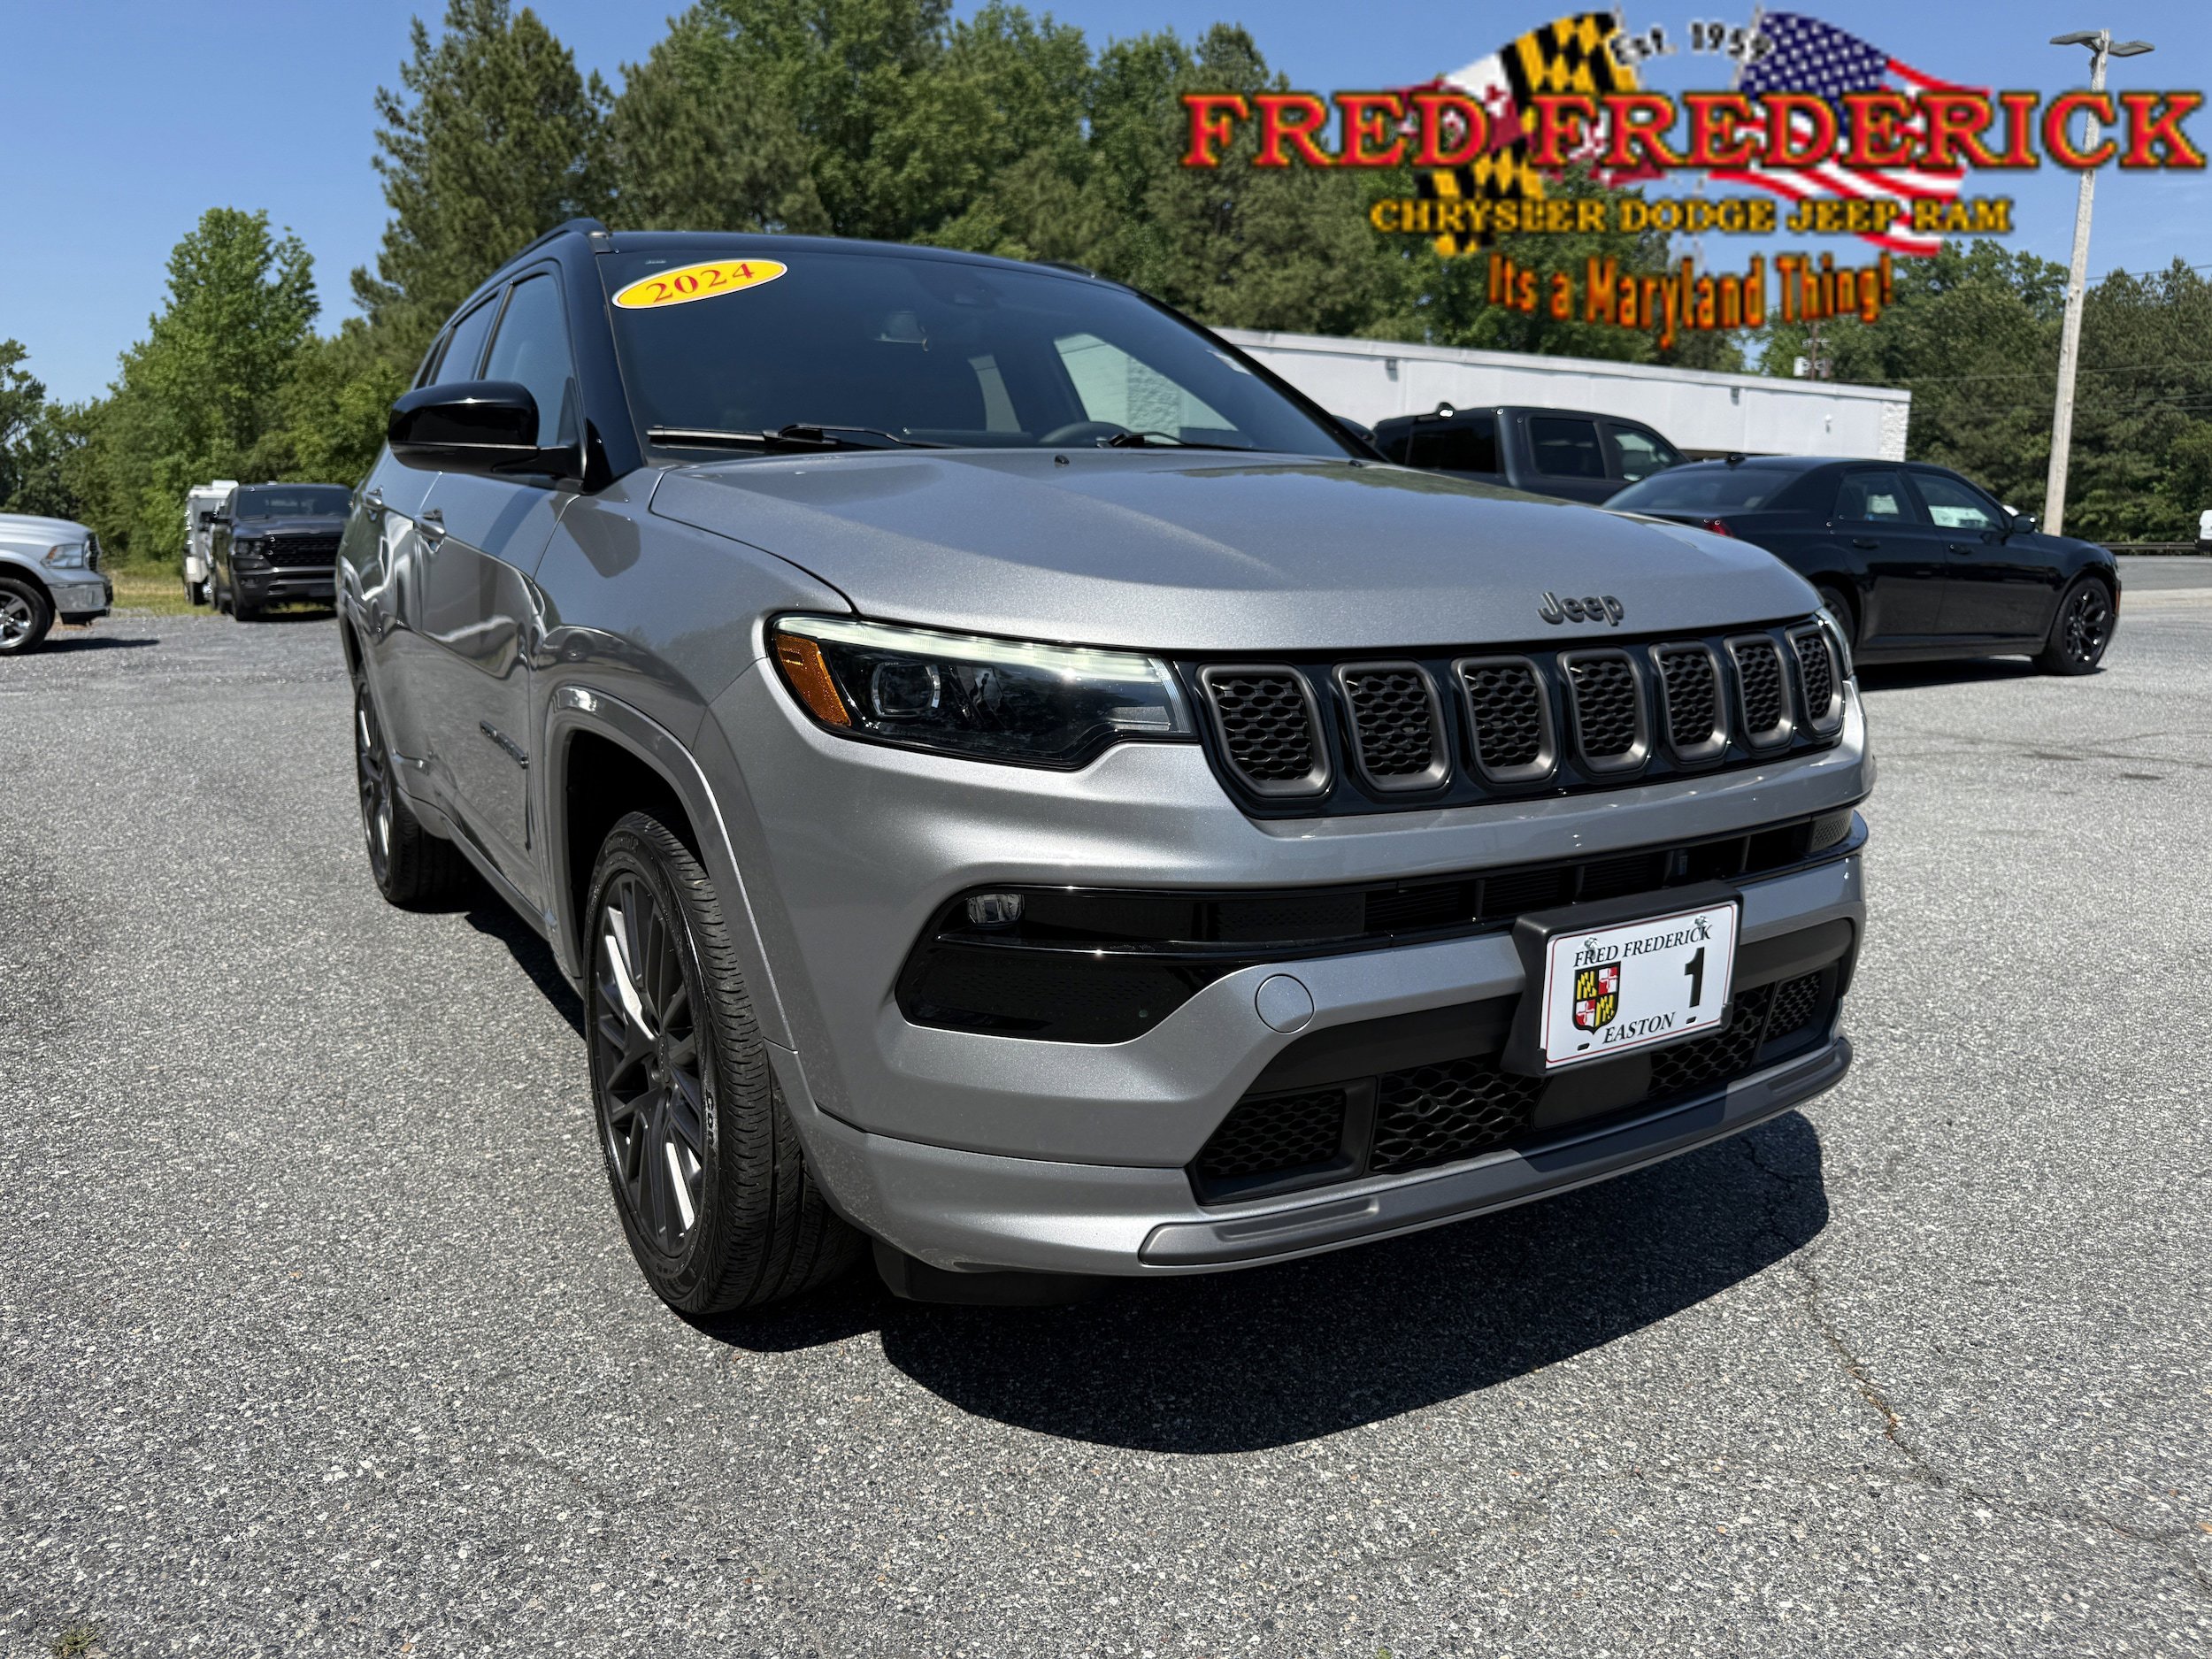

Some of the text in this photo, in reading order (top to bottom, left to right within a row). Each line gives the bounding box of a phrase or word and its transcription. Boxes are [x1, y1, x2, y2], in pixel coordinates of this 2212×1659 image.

[645, 262, 756, 303] 2024
[1537, 591, 1624, 627] Jeep
[1573, 924, 1713, 969] FRED FREDERICK
[1684, 946, 1706, 1009] 1
[1602, 1011, 1676, 1045] EASTON
